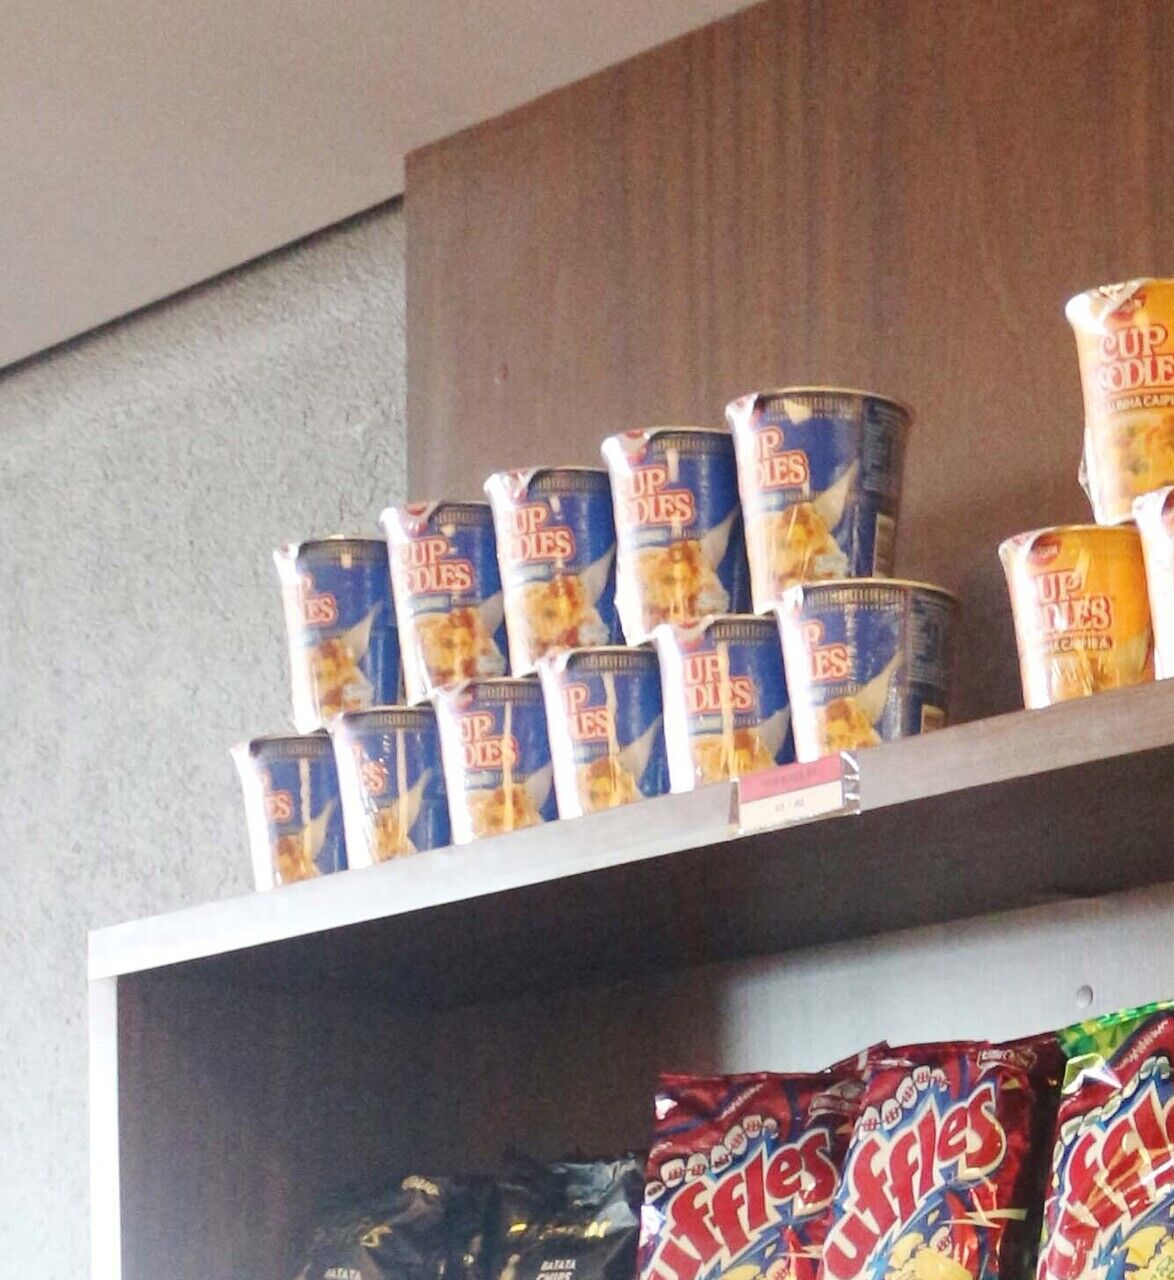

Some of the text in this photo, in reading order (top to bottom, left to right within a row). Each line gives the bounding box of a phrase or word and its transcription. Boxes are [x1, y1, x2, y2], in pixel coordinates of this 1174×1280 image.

[627, 466, 669, 496] UP
[630, 488, 695, 527] DLES
[514, 529, 574, 563] DLES
[404, 560, 474, 594] ODLES
[1036, 570, 1082, 601] UP
[1042, 596, 1112, 632] DLES
[686, 675, 755, 714] DLES
[540, 1259, 576, 1271] BATATA
